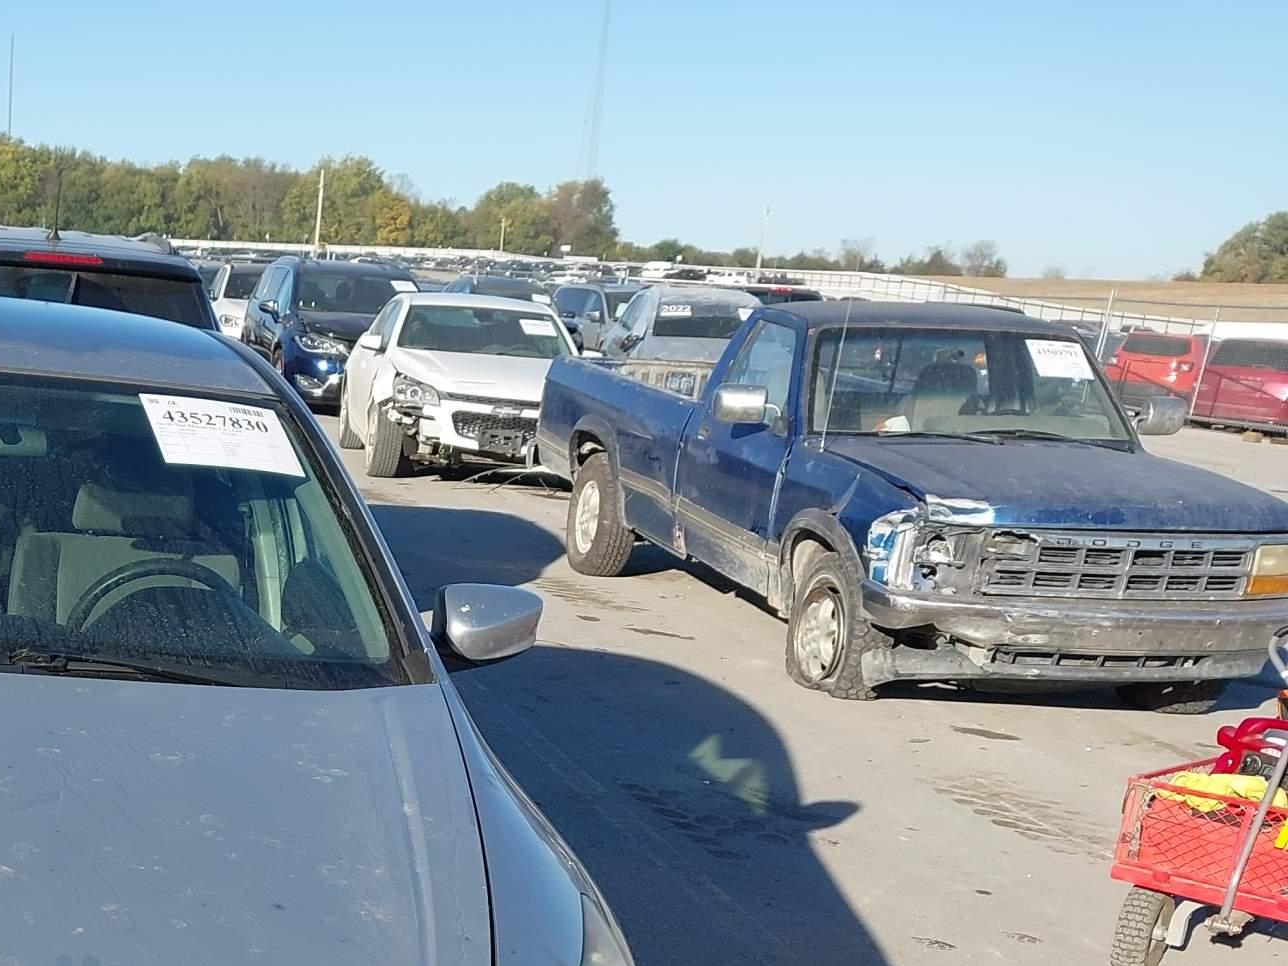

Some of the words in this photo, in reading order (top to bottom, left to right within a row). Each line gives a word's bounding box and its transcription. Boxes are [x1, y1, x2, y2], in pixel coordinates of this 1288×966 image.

[661, 304, 692, 312] 2022
[162, 410, 269, 433] 43527830
[1056, 537, 1203, 549] DODGE
